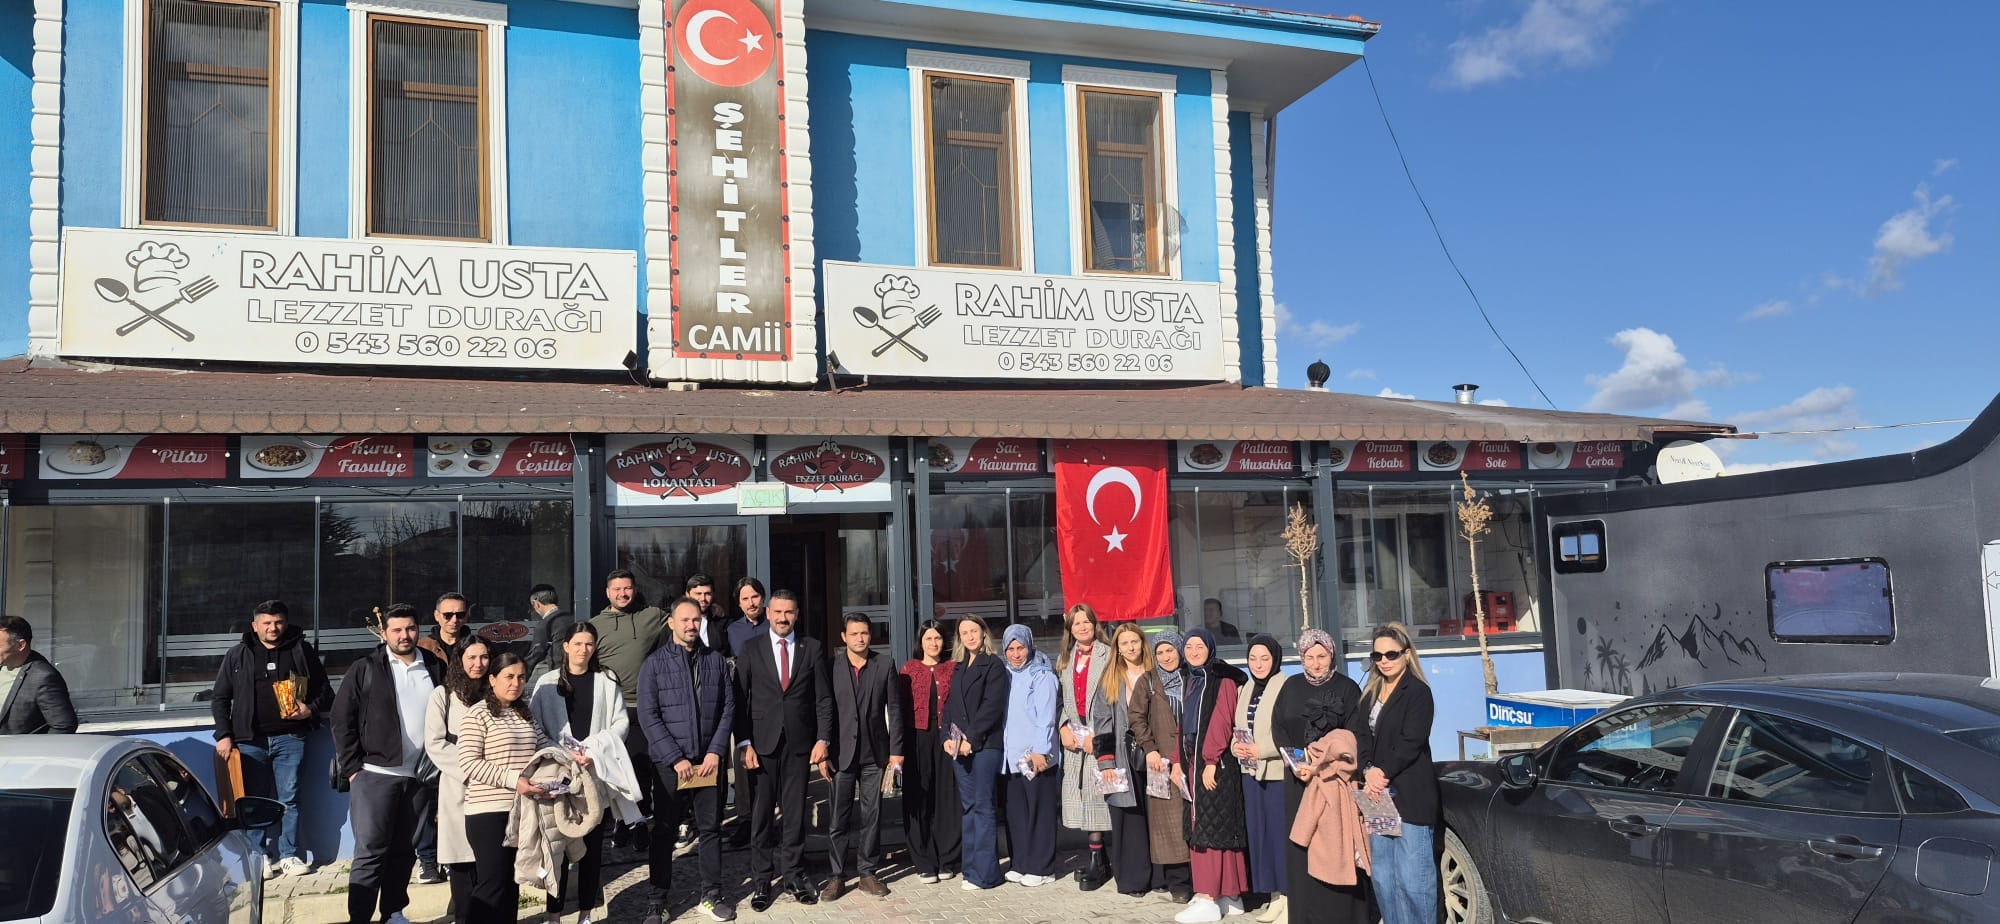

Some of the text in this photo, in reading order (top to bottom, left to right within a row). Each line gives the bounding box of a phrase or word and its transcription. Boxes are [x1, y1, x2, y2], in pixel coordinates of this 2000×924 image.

[711, 102, 752, 314] ŞEHİTLER
[240, 245, 608, 301] RAHİM USTA
[955, 279, 1204, 324] RAHİM USTA
[247, 299, 602, 333] LEZZET DURAĞI
[295, 332, 558, 360] 0 543 560 22 06
[963, 324, 1202, 350] LEZZET DURAĞI
[998, 352, 1173, 372] 0 543 560 22 06
[995, 441, 1020, 454] Sac
[1365, 441, 1404, 453] Orman
[157, 449, 208, 464] Pilav
[706, 449, 741, 467] USTA
[850, 450, 877, 465] USTA
[978, 458, 1038, 471] Kavurma
[1240, 458, 1293, 470] Musakka
[1367, 456, 1404, 469] Kebabı
[338, 459, 407, 477] Fasulye
[643, 478, 716, 488] LOKANTASI
[1489, 702, 1533, 725] Dinçsu
